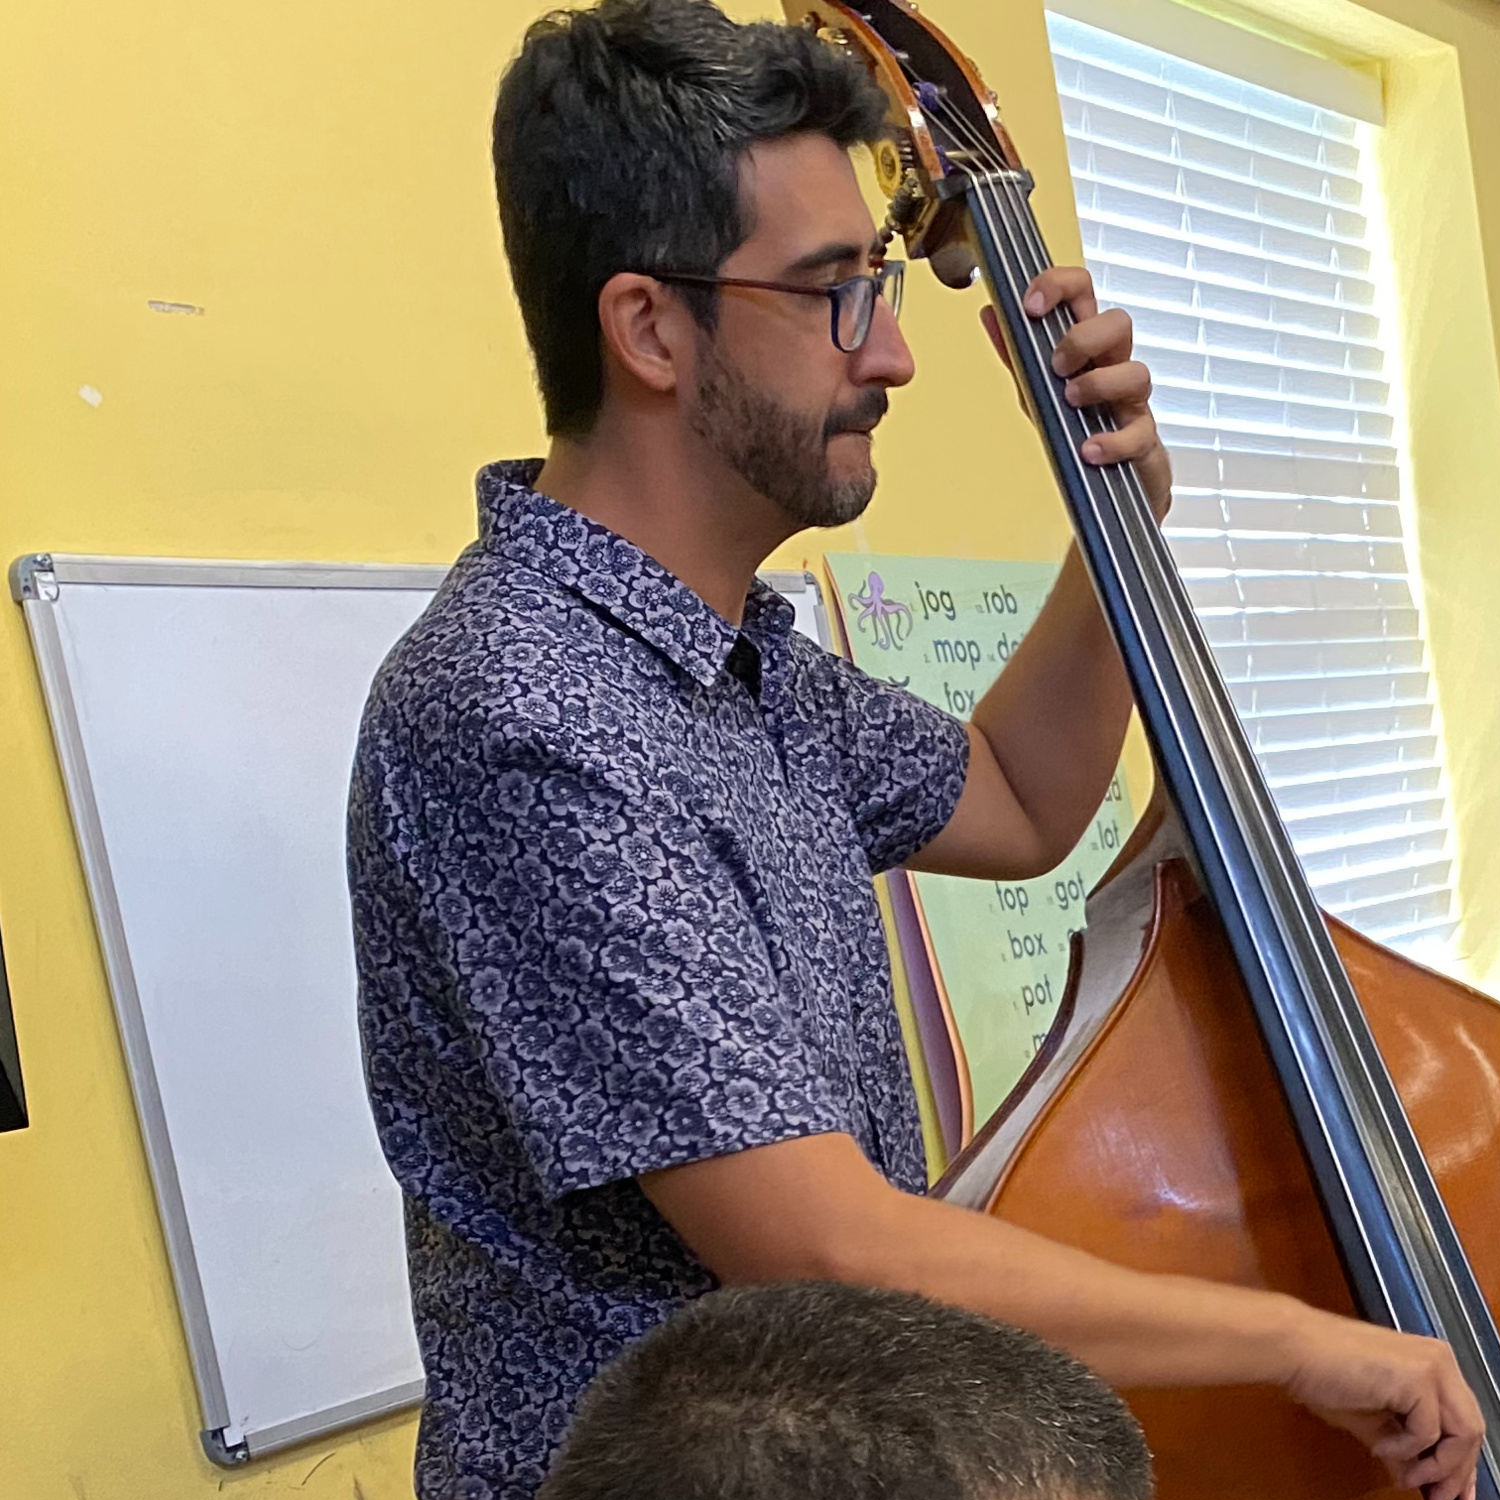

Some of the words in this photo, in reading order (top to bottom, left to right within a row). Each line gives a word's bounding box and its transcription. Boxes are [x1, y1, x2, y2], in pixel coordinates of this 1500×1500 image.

[914, 581, 956, 621] jog
[982, 585, 1018, 615] rob
[932, 638, 981, 671] mop
[944, 681, 976, 713] fox
[1096, 819, 1121, 850] lot
[995, 881, 1029, 917] top
[1055, 870, 1086, 911] got
[1008, 930, 1048, 961] box
[1021, 973, 1054, 1016] pot
